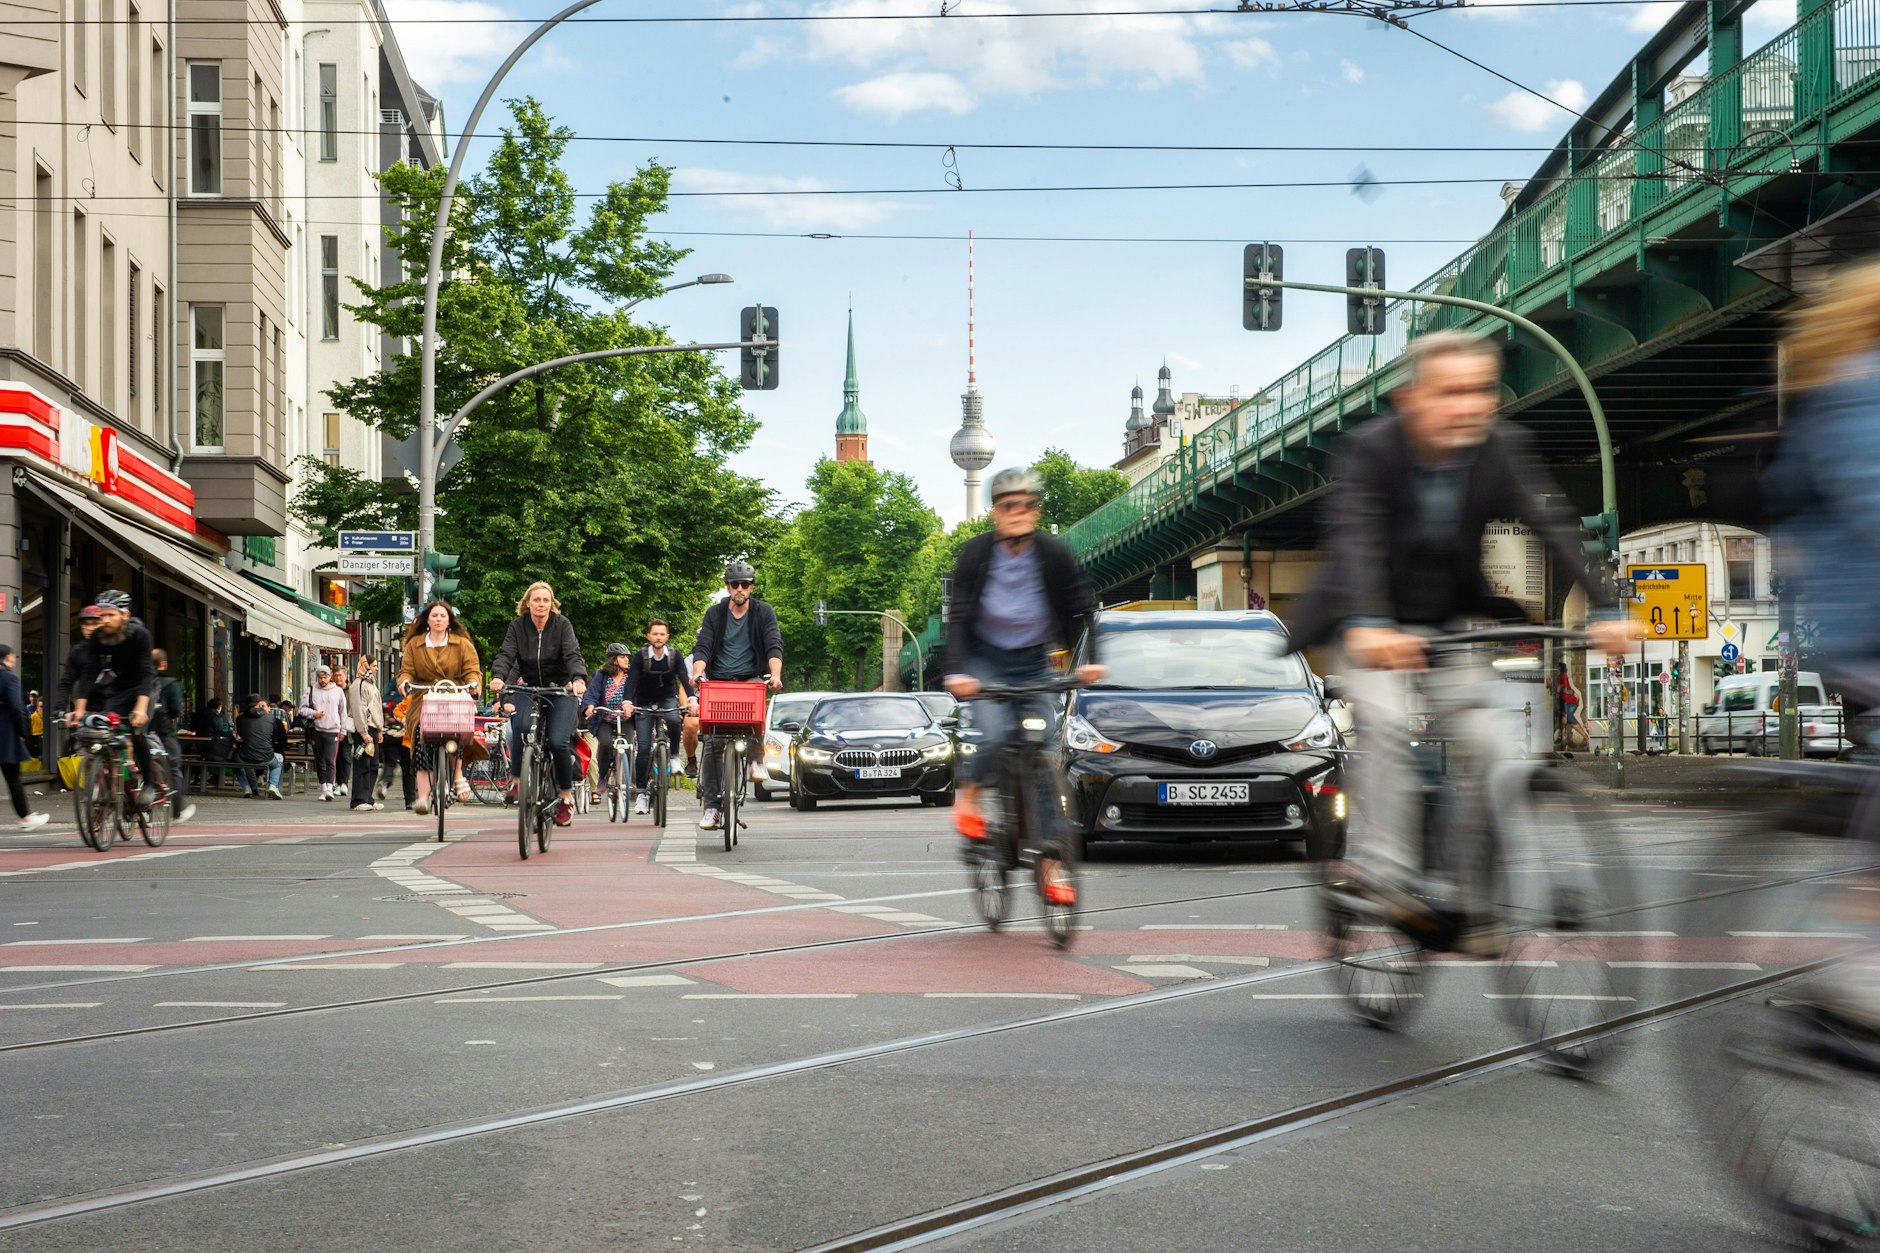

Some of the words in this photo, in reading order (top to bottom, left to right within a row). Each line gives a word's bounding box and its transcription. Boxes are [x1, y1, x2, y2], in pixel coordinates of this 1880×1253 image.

[1513, 526, 1536, 535] Berli
[342, 560, 380, 571] Danziger
[382, 560, 411, 571] Straße
[1636, 582, 1670, 591] iedrichshain
[862, 770, 868, 778] B
[873, 769, 882, 777] TA
[884, 768, 898, 777] 324
[1168, 786, 1178, 800] B
[1188, 785, 1207, 800] SC
[1210, 785, 1247, 800] 2453
